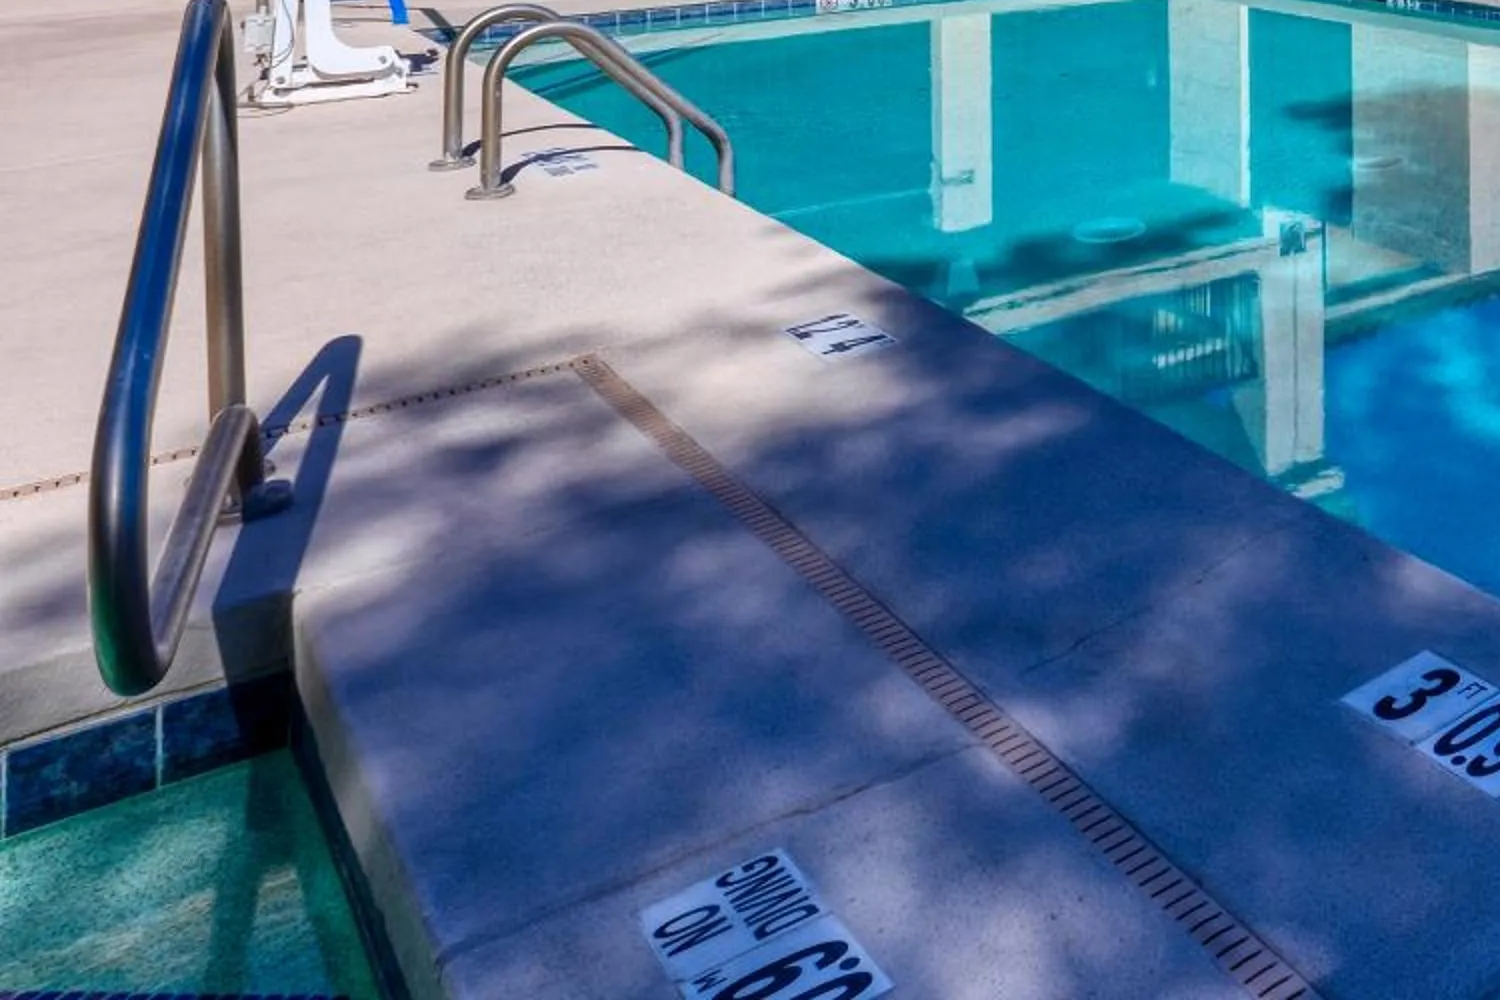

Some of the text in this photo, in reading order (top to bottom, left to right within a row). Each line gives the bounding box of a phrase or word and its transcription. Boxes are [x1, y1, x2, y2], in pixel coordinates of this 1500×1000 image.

[1373, 668, 1489, 721] 3 FT
[715, 855, 820, 941] DIVING
[652, 904, 734, 958] NO
